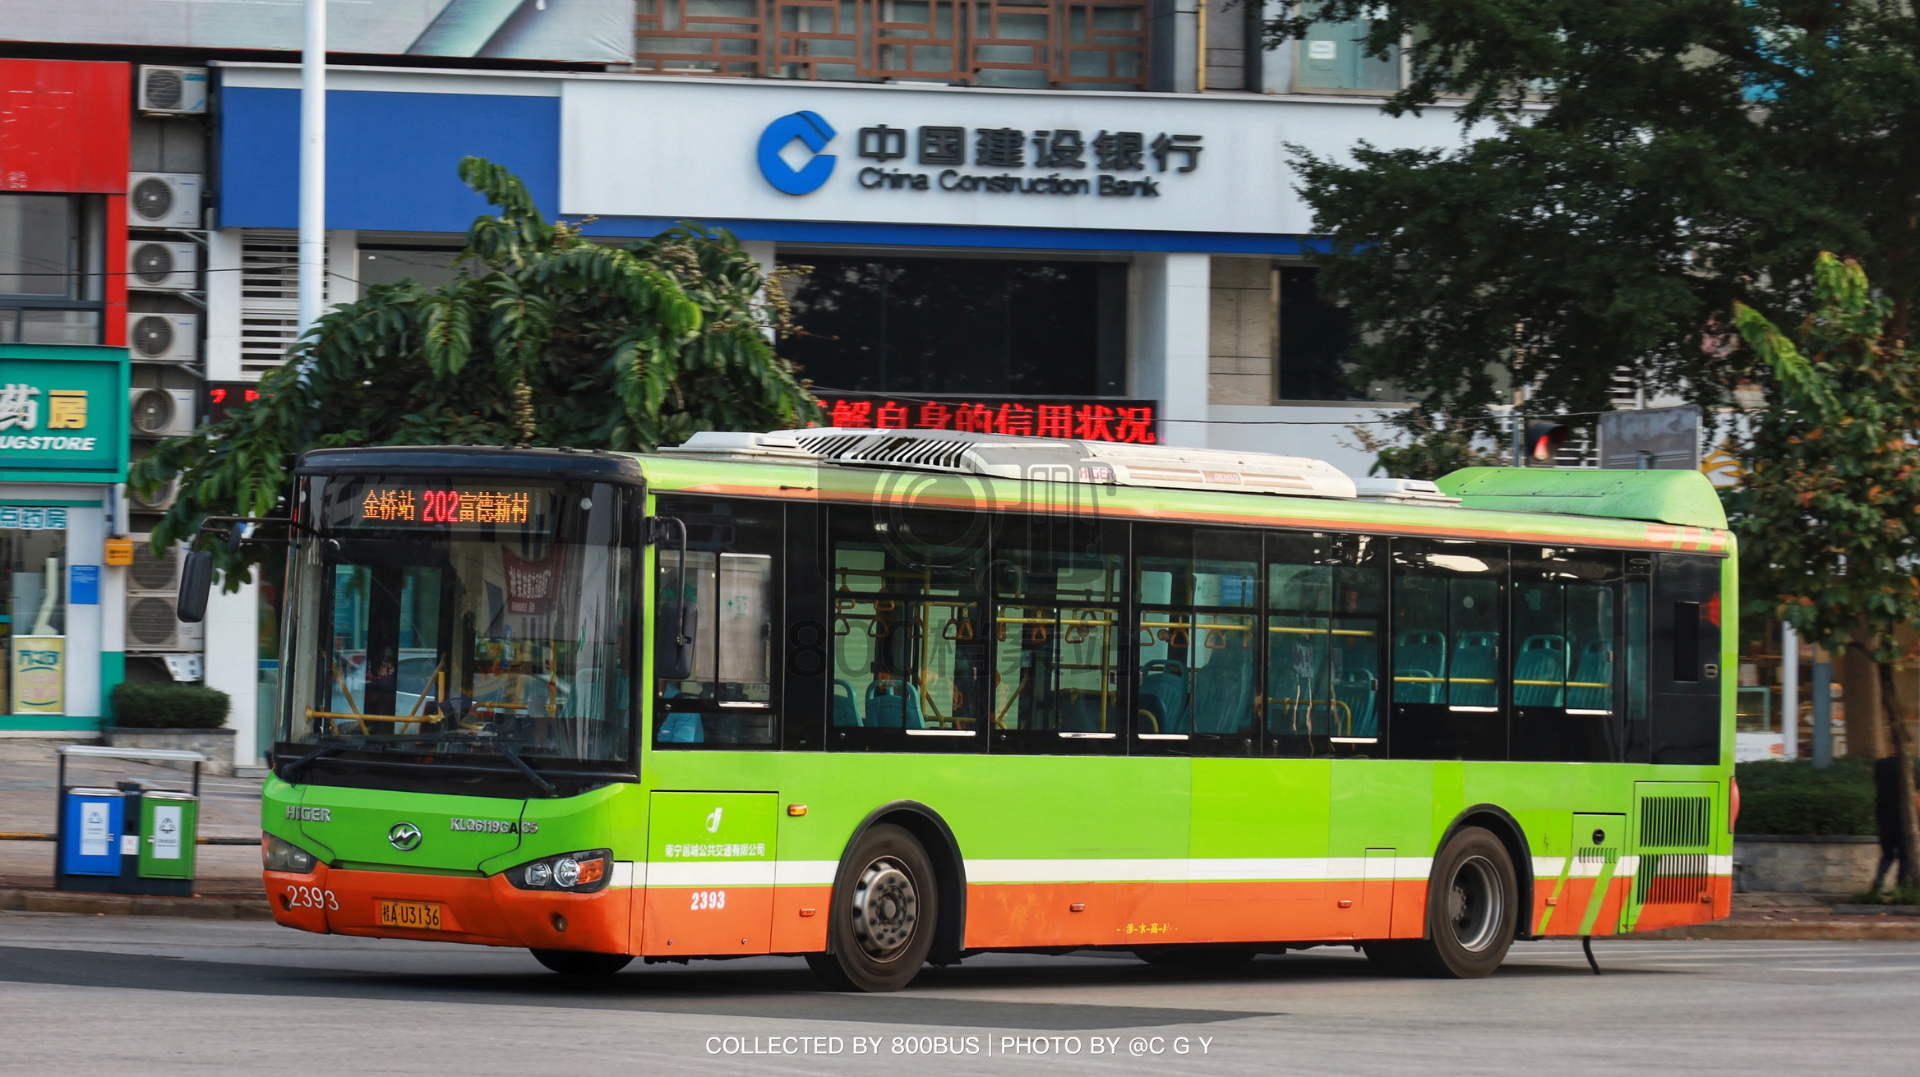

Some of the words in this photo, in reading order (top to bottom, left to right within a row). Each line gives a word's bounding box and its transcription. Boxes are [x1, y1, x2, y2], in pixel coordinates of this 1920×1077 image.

[858, 123, 1203, 173] 中国建设银行
[859, 167, 930, 190] China
[938, 170, 1089, 194] Construction
[1097, 174, 1160, 197] Bank
[808, 399, 1156, 444] 解自身的信用状况
[362, 489, 416, 521] 金桥站
[422, 490, 460, 522] 202
[459, 491, 530, 523] 富德新村
[286, 805, 331, 822] HIGER
[287, 885, 339, 911] 2393
[690, 890, 726, 910] 2393
